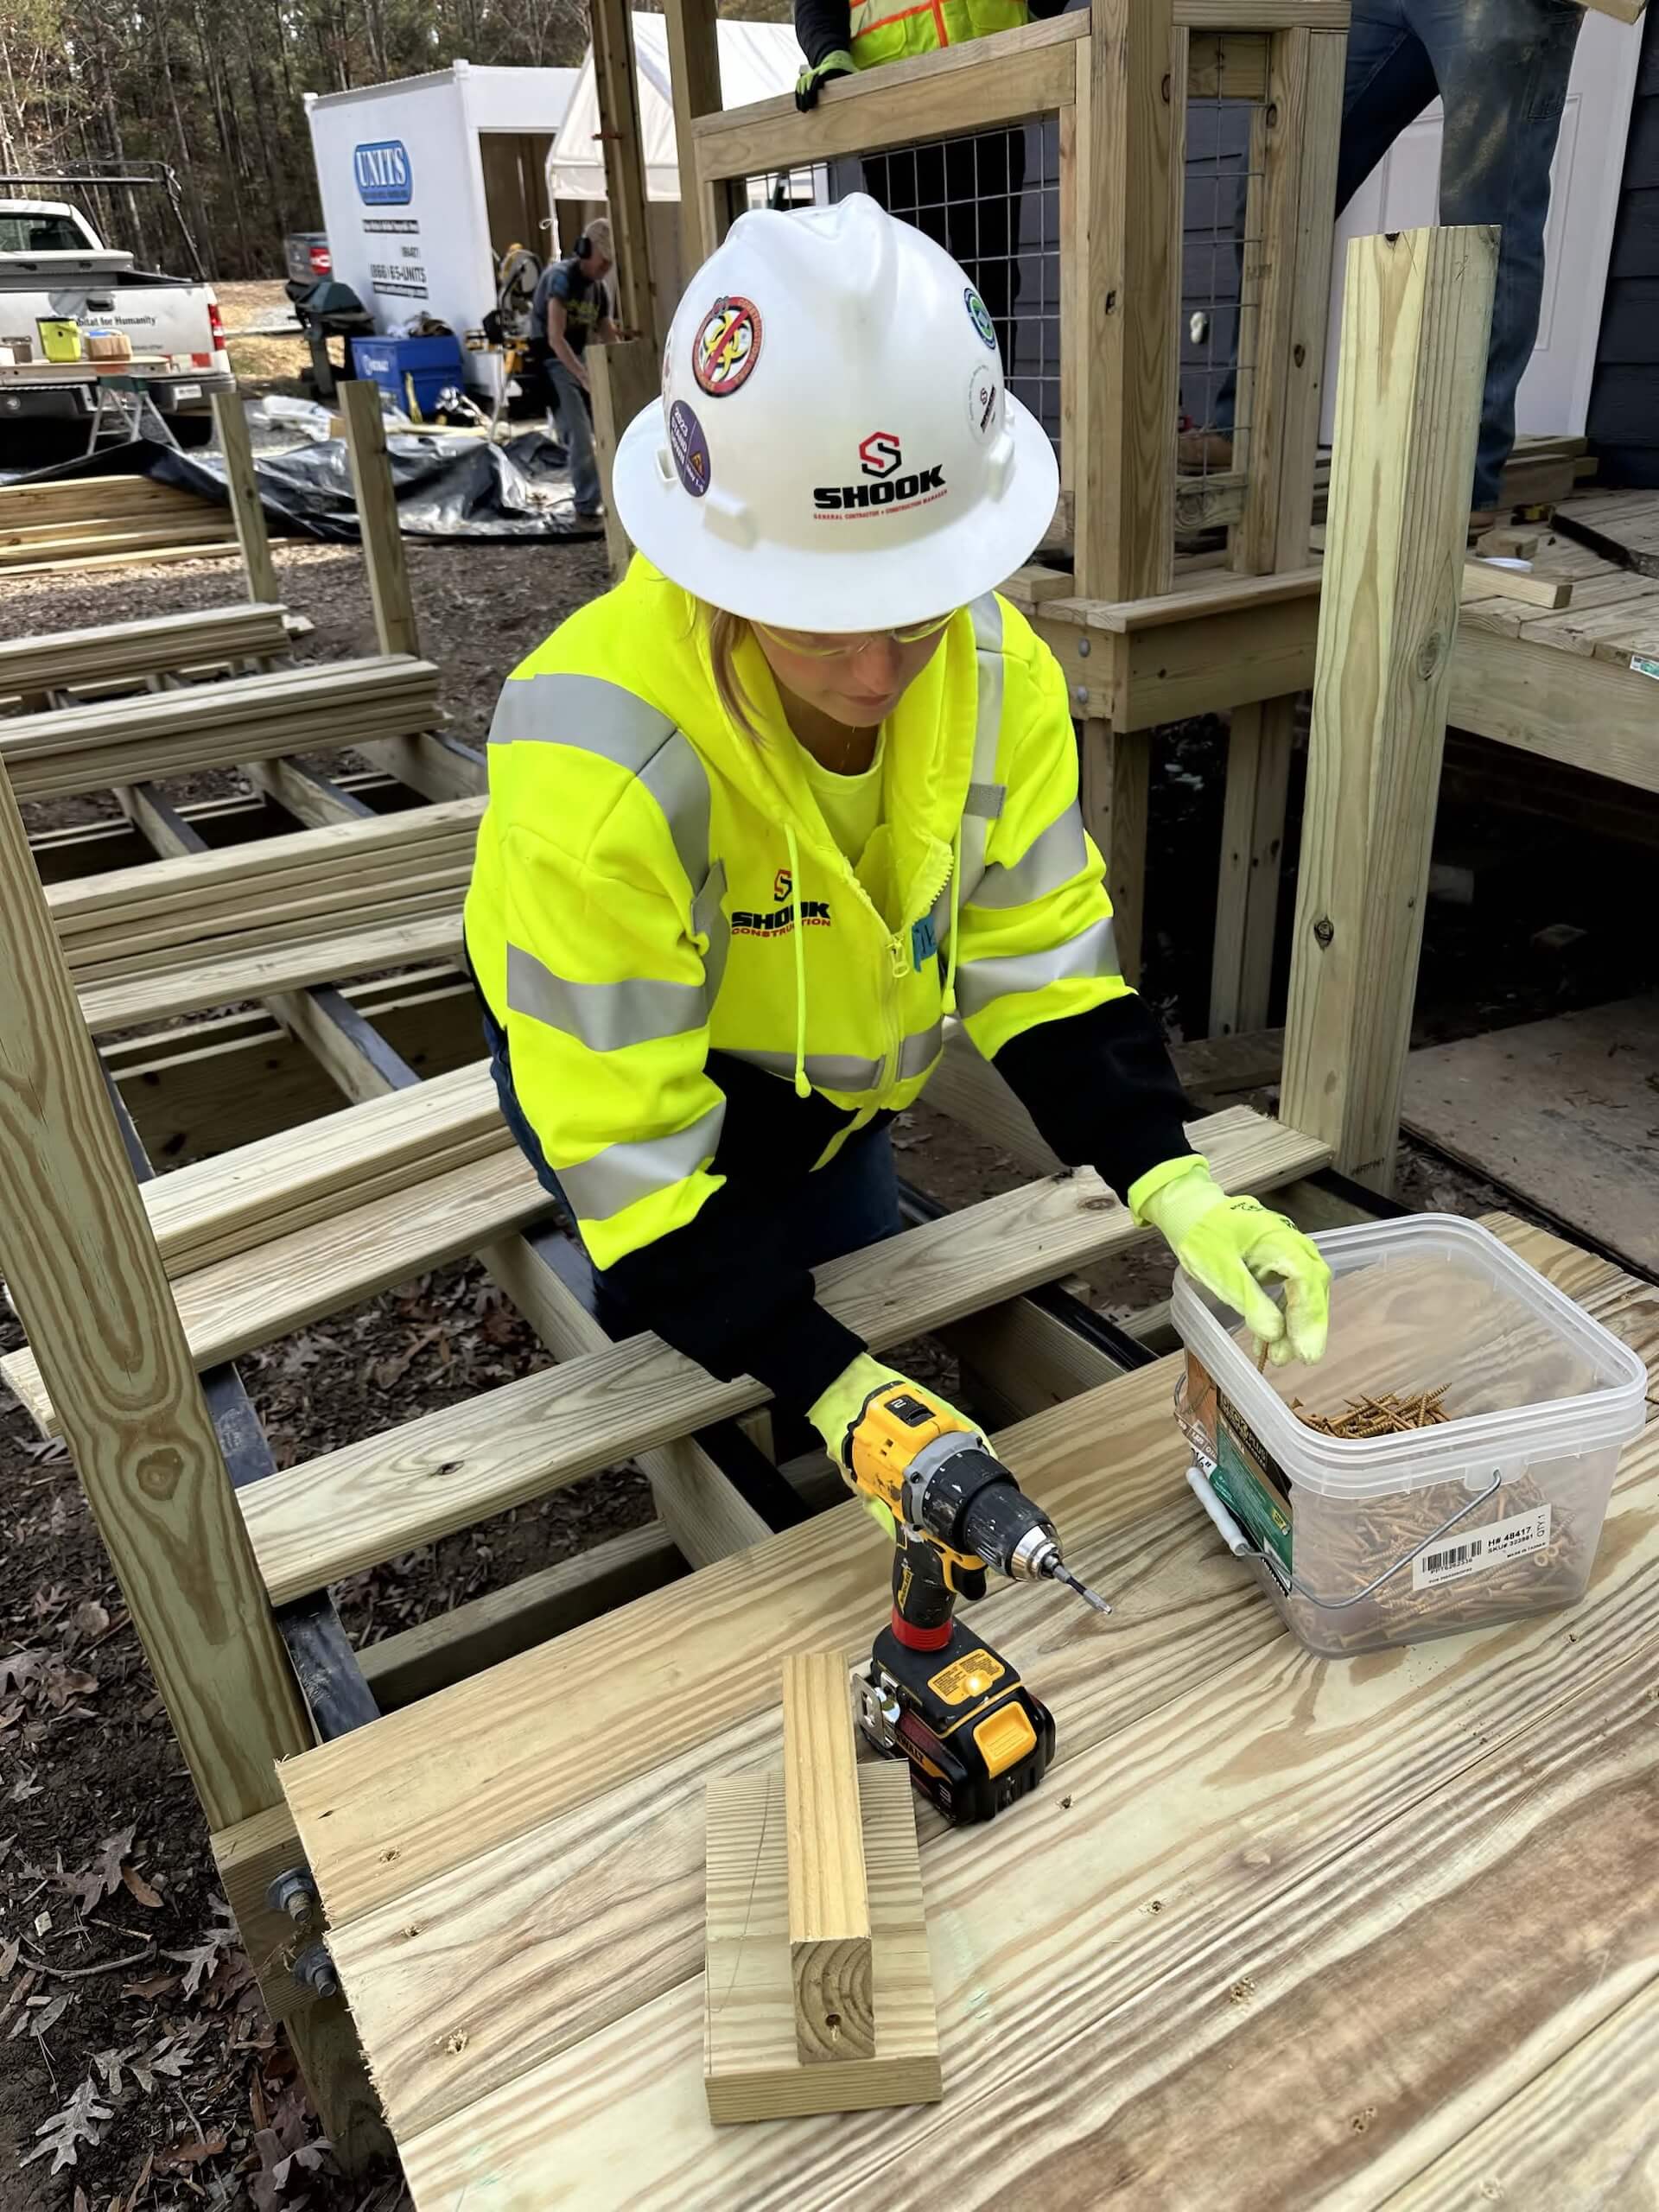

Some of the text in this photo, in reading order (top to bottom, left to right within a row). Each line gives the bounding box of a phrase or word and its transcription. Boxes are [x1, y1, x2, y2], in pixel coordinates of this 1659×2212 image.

[356, 147, 406, 187] UNITS
[114, 315, 156, 327] Humanity
[814, 464, 946, 509] SHOOK
[845, 511, 880, 519] CONTRACTOR
[886, 500, 922, 514] CONSTRUCTION
[923, 489, 948, 505] MANAGER
[1488, 1526, 1531, 1548] H# 48417
[1536, 1520, 1546, 1538] QTY
[1488, 1543, 1508, 1554] SKU#
